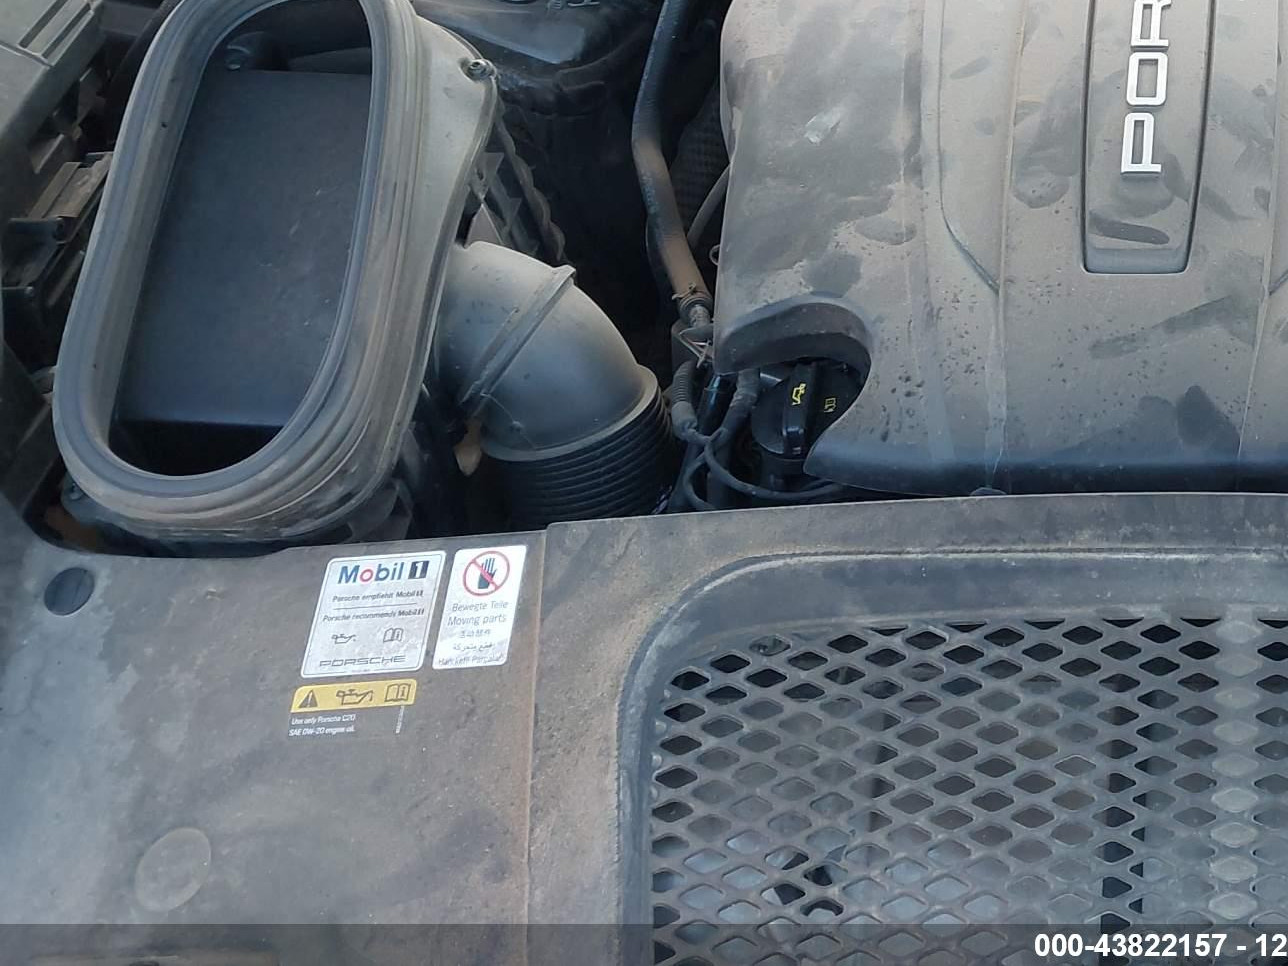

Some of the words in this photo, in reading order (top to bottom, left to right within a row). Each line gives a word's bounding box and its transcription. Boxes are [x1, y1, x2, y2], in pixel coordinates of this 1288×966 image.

[338, 562, 404, 584] Mobil
[332, 594, 360, 602] Porsche
[396, 590, 415, 598] Mobil
[452, 602, 488, 612] Bewegte
[491, 600, 509, 609] Teile
[322, 614, 351, 622] Porsche
[397, 609, 417, 617] Mobil
[447, 616, 481, 626] Moving
[483, 614, 507, 625] parts
[319, 655, 406, 667] PORSCHE
[318, 715, 342, 723] Porsche
[289, 728, 301, 736] SAE
